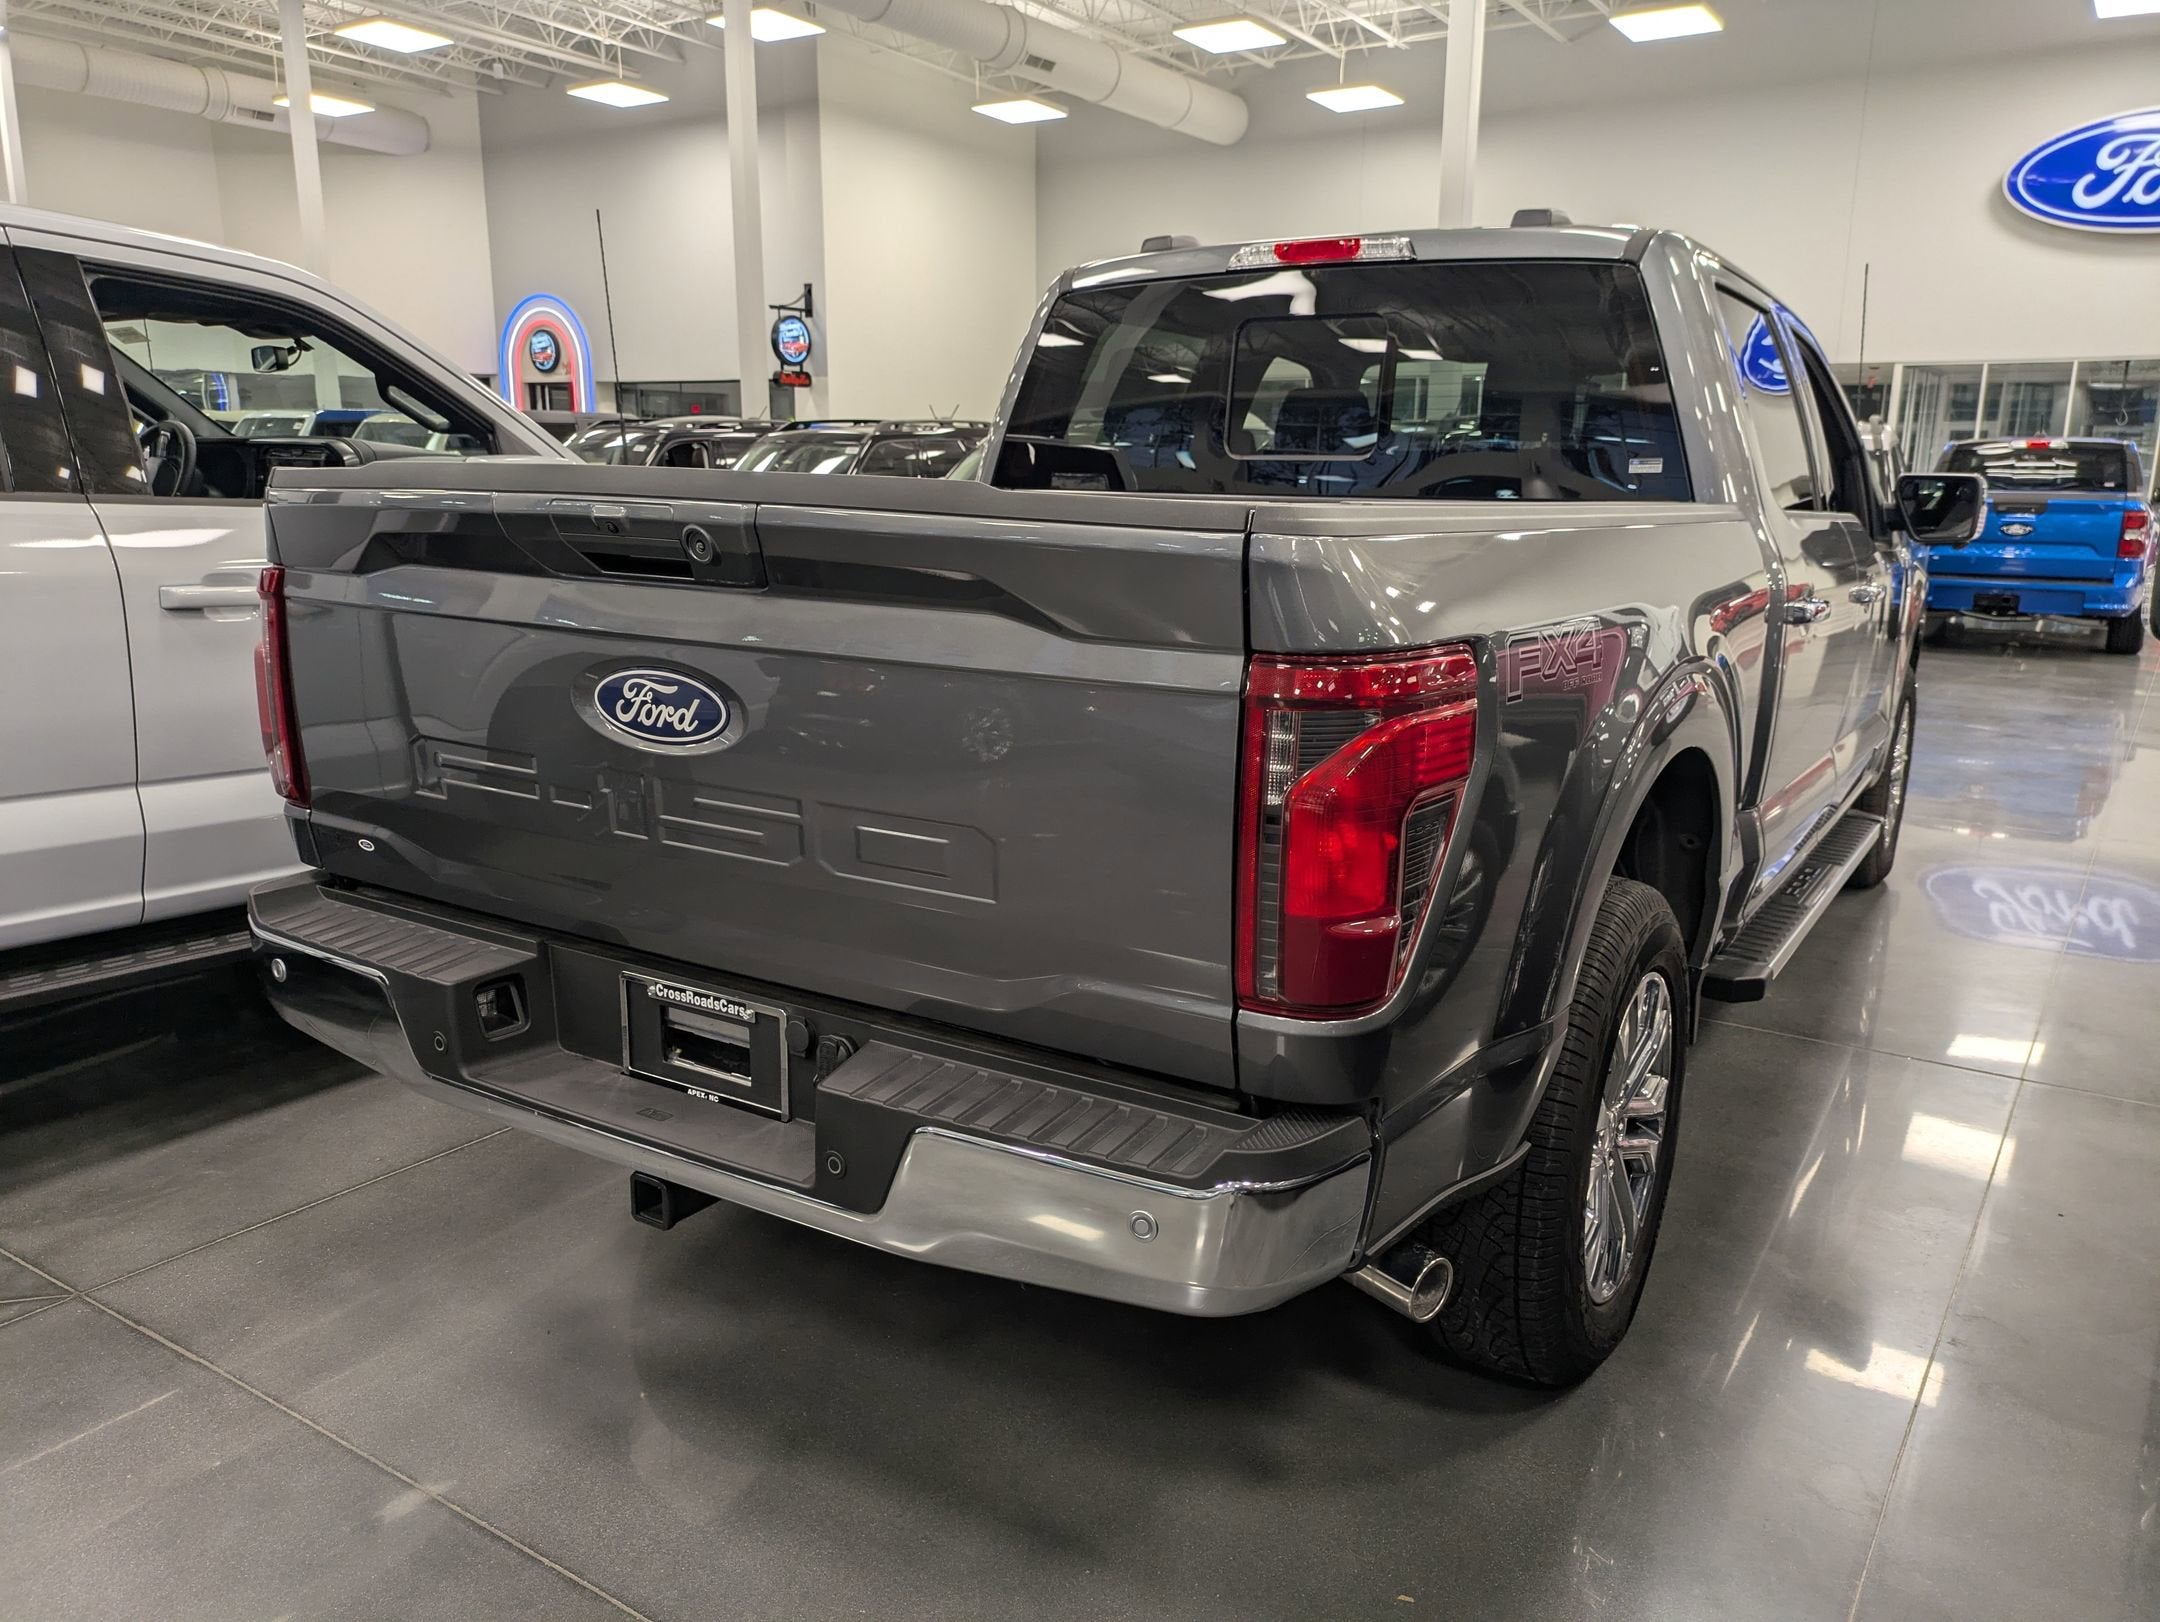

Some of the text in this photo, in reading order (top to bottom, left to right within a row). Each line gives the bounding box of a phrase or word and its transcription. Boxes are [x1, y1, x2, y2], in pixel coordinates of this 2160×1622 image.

[2071, 132, 2160, 210] Fo
[1504, 617, 1604, 705] FX4
[615, 678, 701, 733] Ford
[409, 733, 997, 905] F-150
[655, 983, 746, 1019] CrossRoadsCars
[708, 1094, 720, 1103] NC
